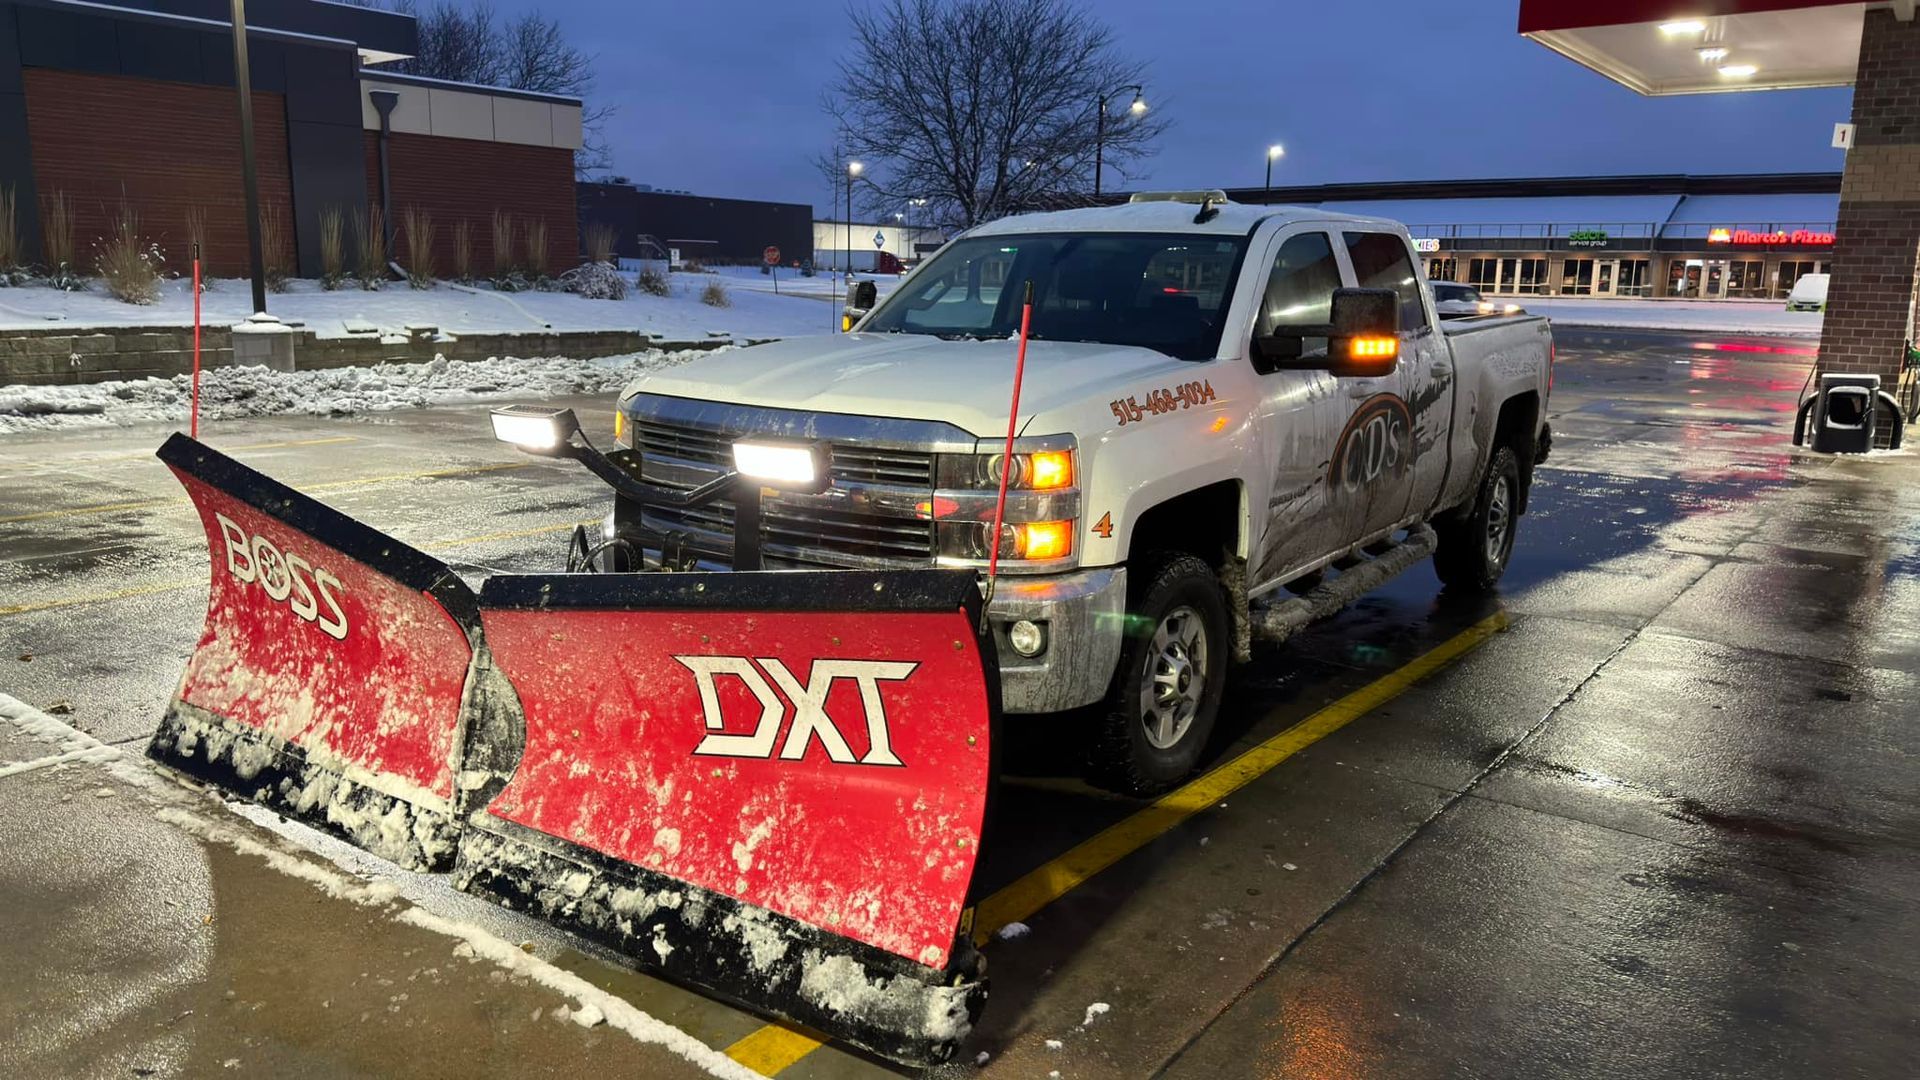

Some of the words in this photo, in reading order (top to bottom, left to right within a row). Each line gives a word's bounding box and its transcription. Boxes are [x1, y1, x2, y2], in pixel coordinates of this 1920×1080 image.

[1840, 129, 1846, 142] 1
[1733, 230, 1787, 244] Marco's
[1791, 229, 1834, 244] Pizza
[1091, 510, 1114, 538] 4
[215, 511, 348, 641] BOSS
[670, 654, 922, 767] DXT
